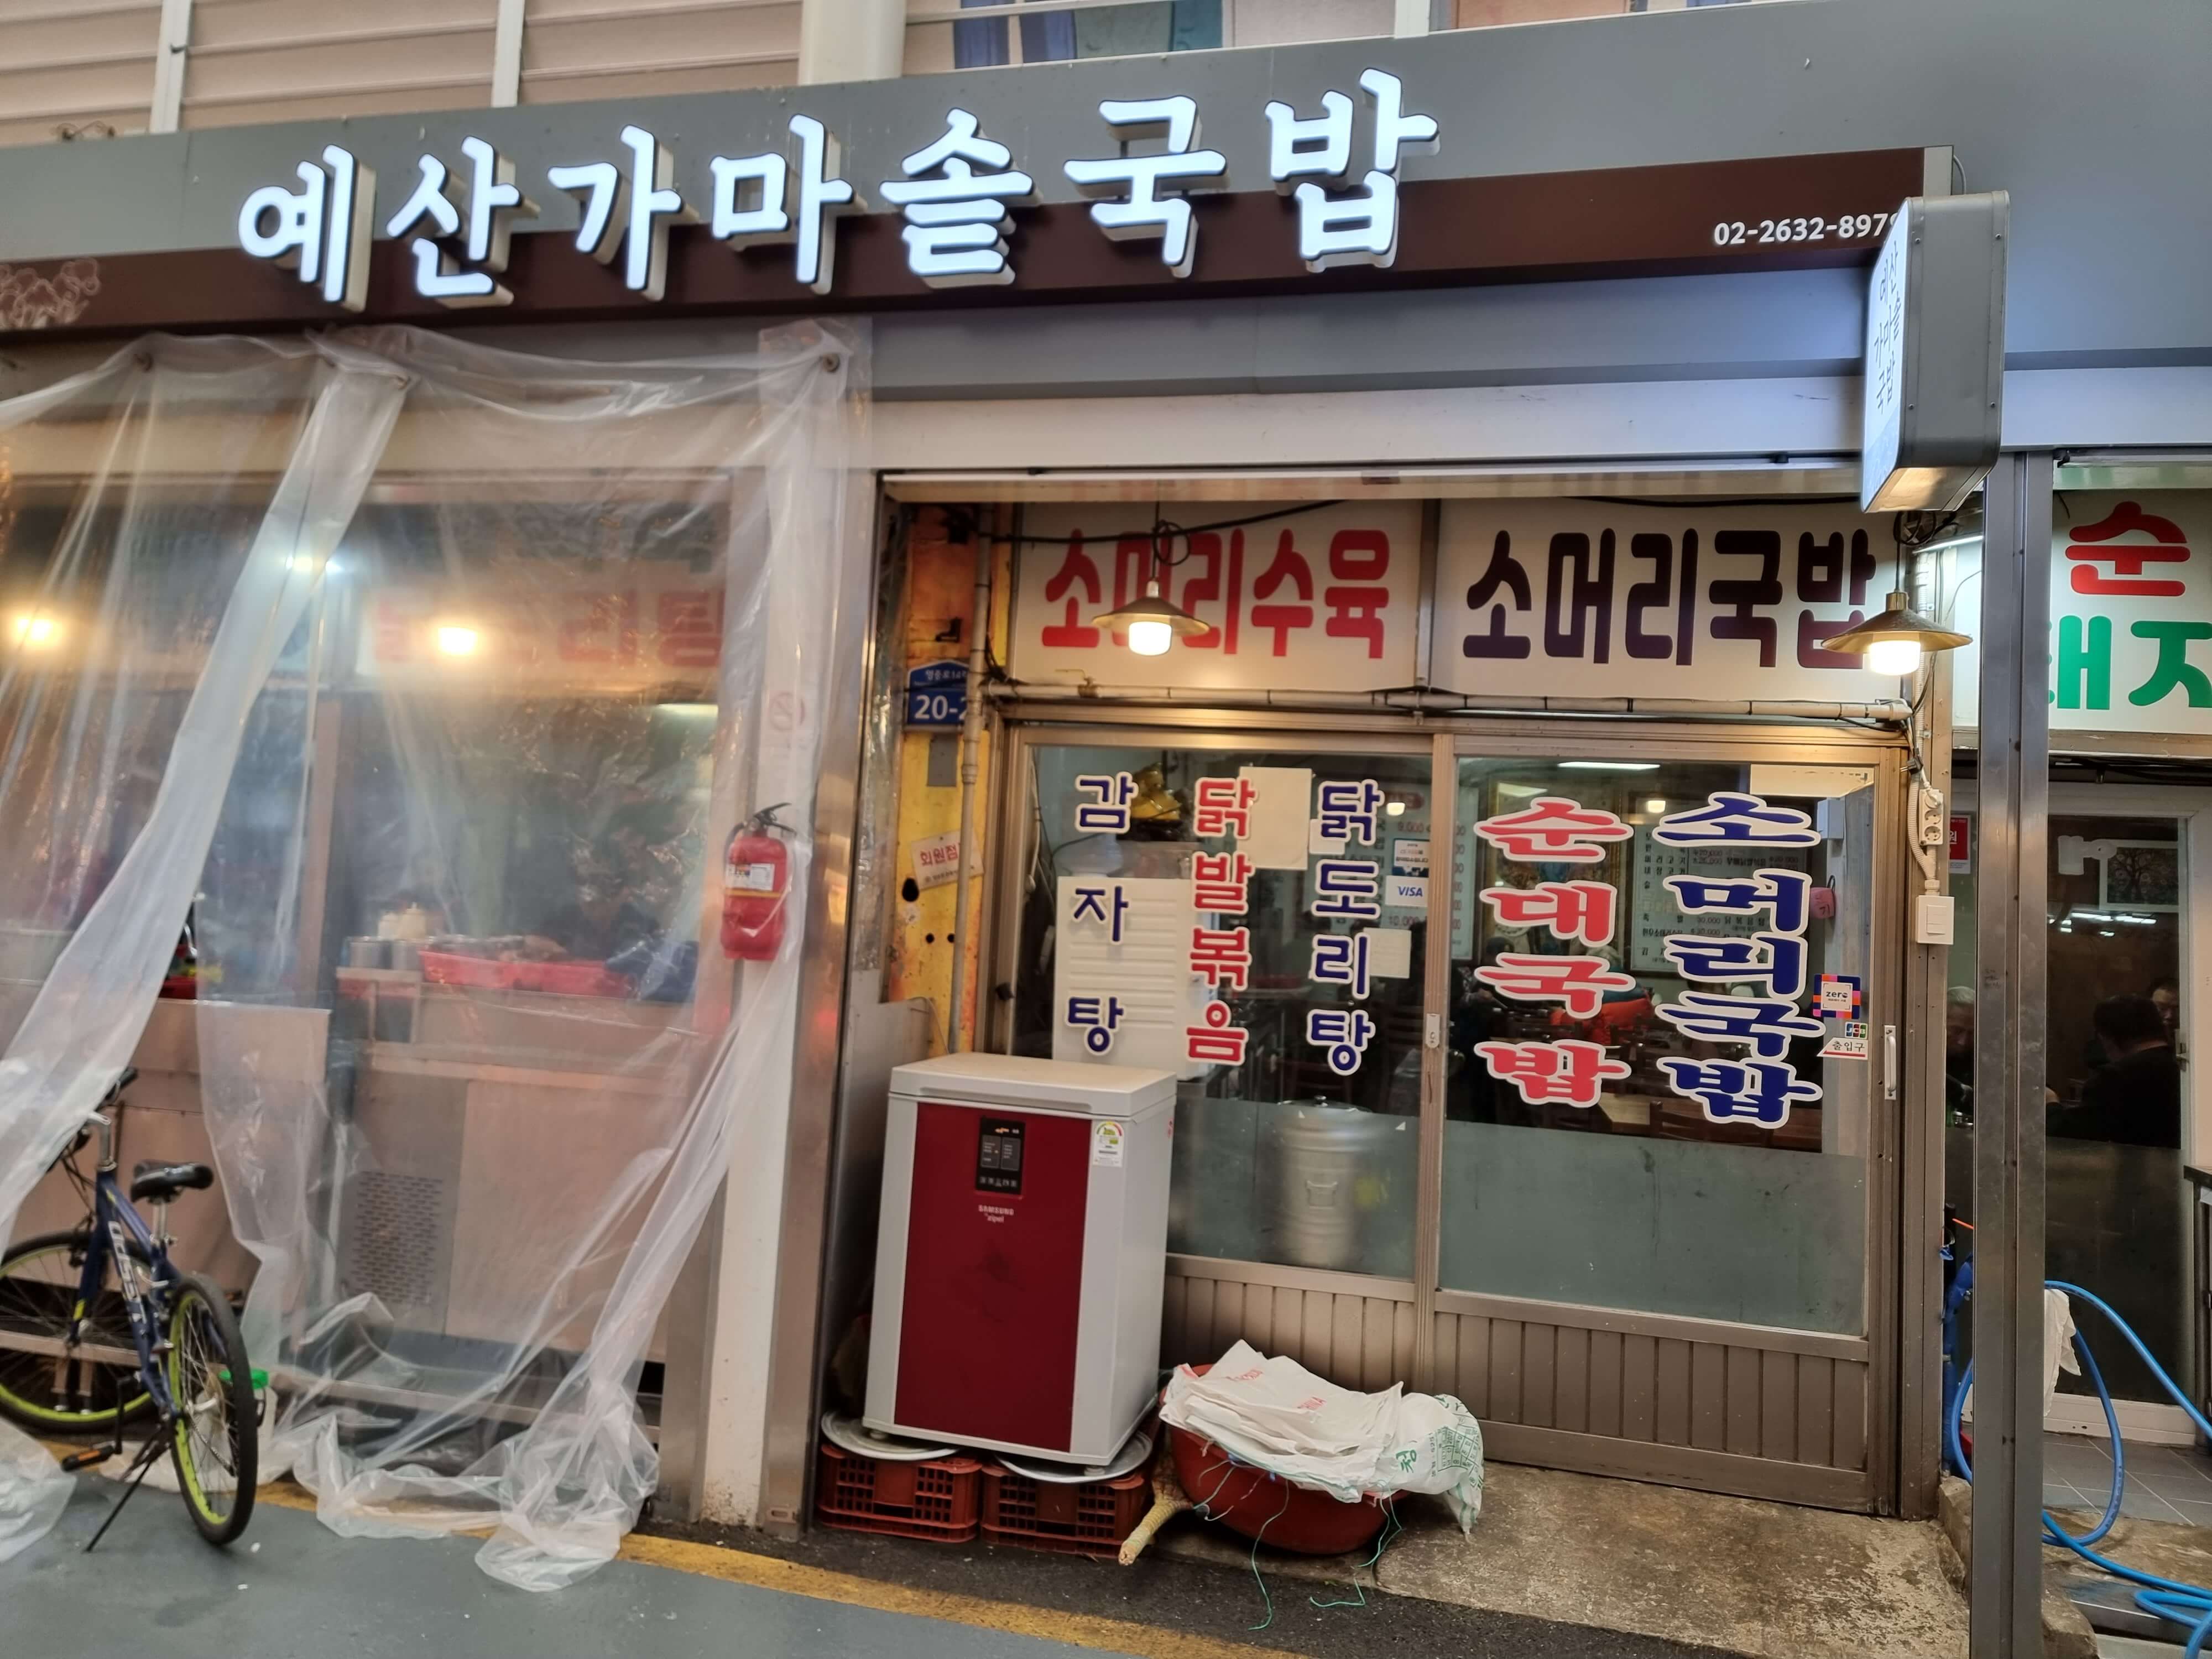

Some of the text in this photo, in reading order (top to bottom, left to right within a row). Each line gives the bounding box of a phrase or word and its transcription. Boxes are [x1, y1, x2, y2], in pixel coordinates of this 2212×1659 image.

[1879, 239, 1898, 305] 예산
[1874, 290, 1902, 369] 가마솥
[1876, 349, 1896, 415] 국밥
[1462, 527, 1877, 670] 소머리국밥
[1067, 774, 1135, 1053] 감자탕
[1185, 776, 1257, 1063] 닭발볶음
[1310, 781, 1383, 1072] 닭도리탕
[1398, 886, 1423, 897] VISA
[1476, 799, 1632, 1104] 순대국밥
[1656, 794, 1823, 1125] 소머리국밥
[1825, 990, 1848, 999] zero
[1832, 1040, 1865, 1052] 출입구
